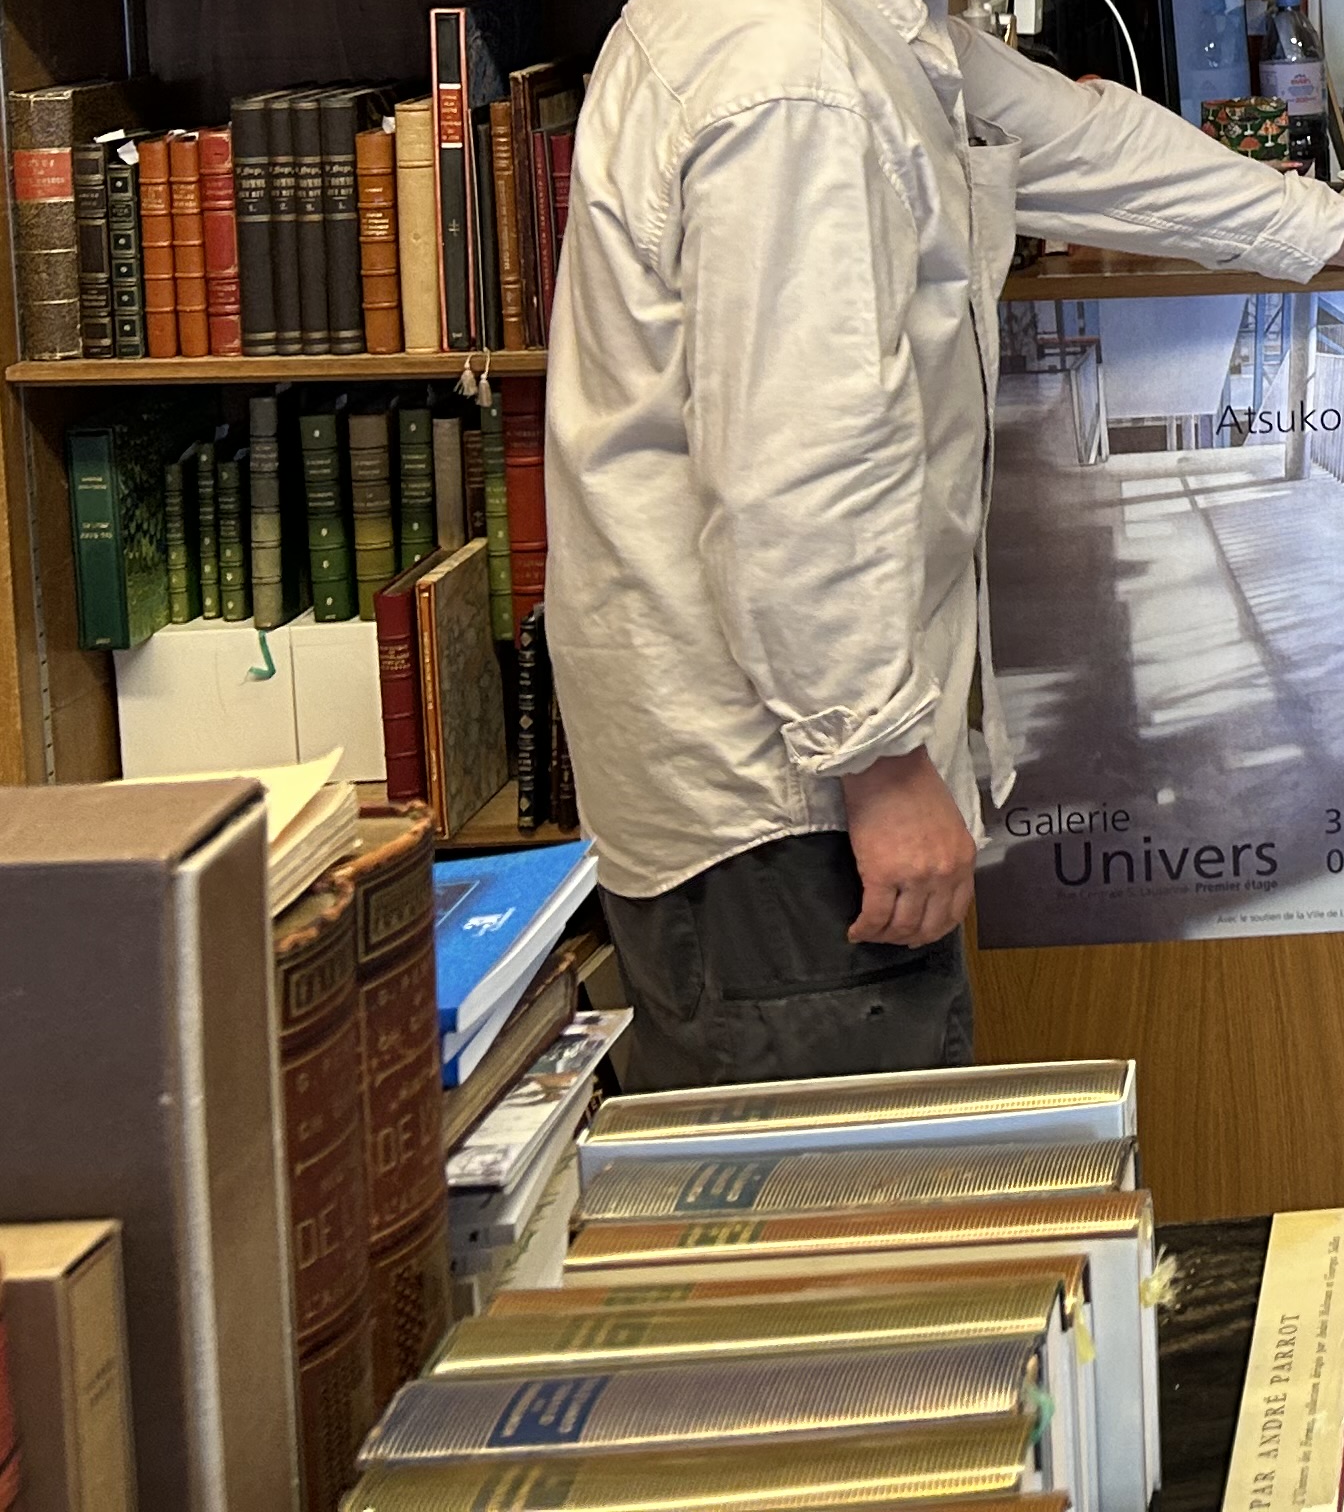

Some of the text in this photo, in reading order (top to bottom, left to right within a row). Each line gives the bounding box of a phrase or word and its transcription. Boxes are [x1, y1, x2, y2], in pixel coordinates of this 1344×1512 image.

[1215, 401, 1342, 438] Atsuko
[1004, 804, 1131, 838] Galerie
[1053, 835, 1279, 887] Univers
[1194, 879, 1241, 894] Premier
[1244, 879, 1278, 893] étage
[1217, 913, 1238, 925] Avec
[1249, 912, 1281, 923] soutien
[1282, 911, 1295, 922] de
[1296, 911, 1305, 921] la
[1306, 909, 1325, 921] Ville
[1326, 909, 1338, 919] de
[1250, 1313, 1300, 1511] PAR ANDRÉ PARROT
